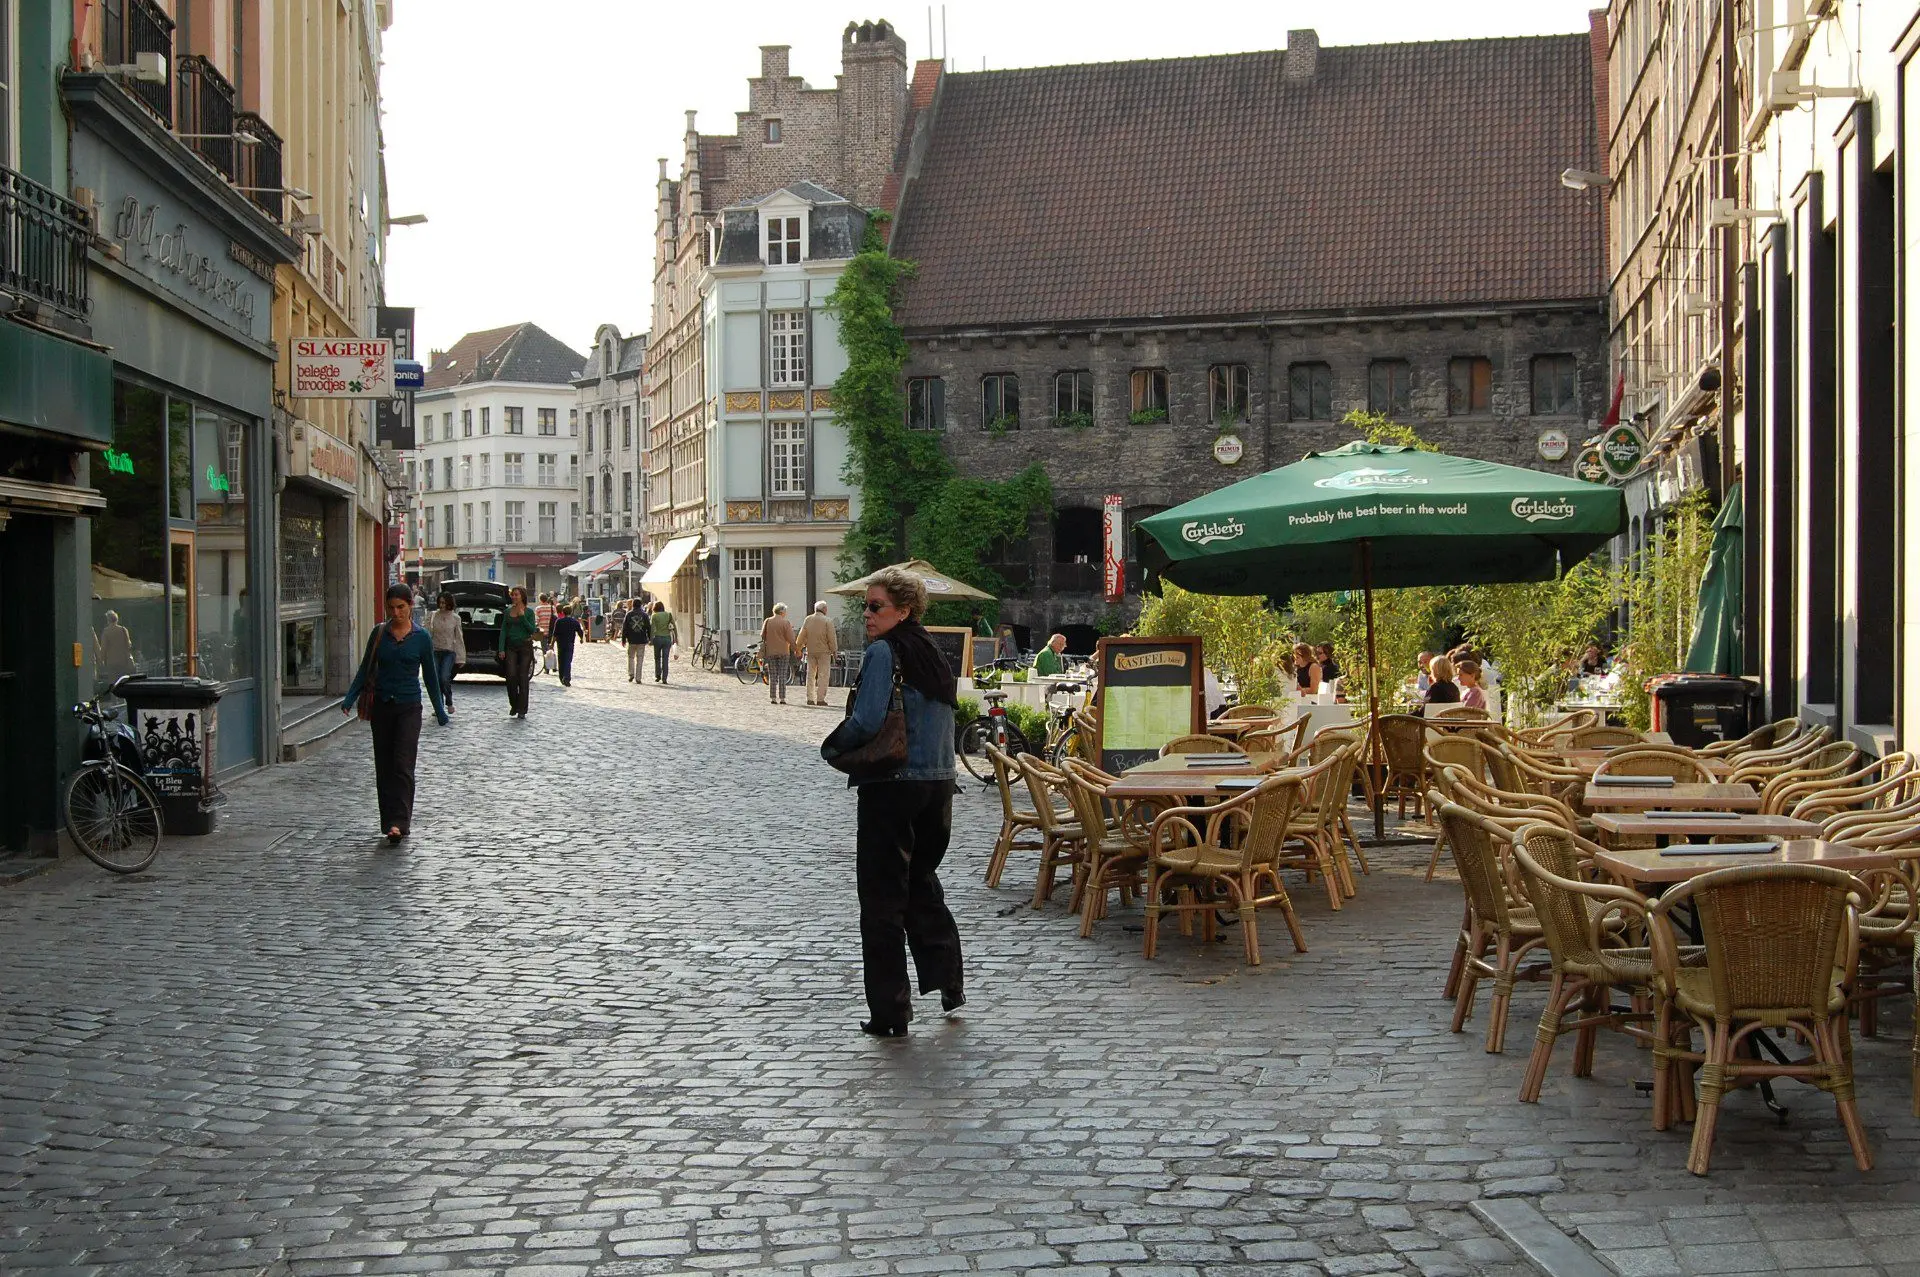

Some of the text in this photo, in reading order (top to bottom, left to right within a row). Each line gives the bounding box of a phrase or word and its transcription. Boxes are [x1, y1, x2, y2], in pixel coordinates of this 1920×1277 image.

[297, 342, 387, 356] SLAGERIJ
[296, 364, 340, 379] belegde
[296, 378, 346, 393] broodjes
[1605, 441, 1640, 455] Carlsberg
[1613, 454, 1632, 462] Beer
[1578, 461, 1604, 473] Carlsber
[1289, 503, 1467, 526] Probably the best beer in the world
[1511, 497, 1574, 522] Carlsberg
[1182, 518, 1245, 545] Carlsberg
[1117, 653, 1166, 669] KASTEEL
[155, 777, 182, 785] Le Bleu
[161, 784, 182, 792] Large
